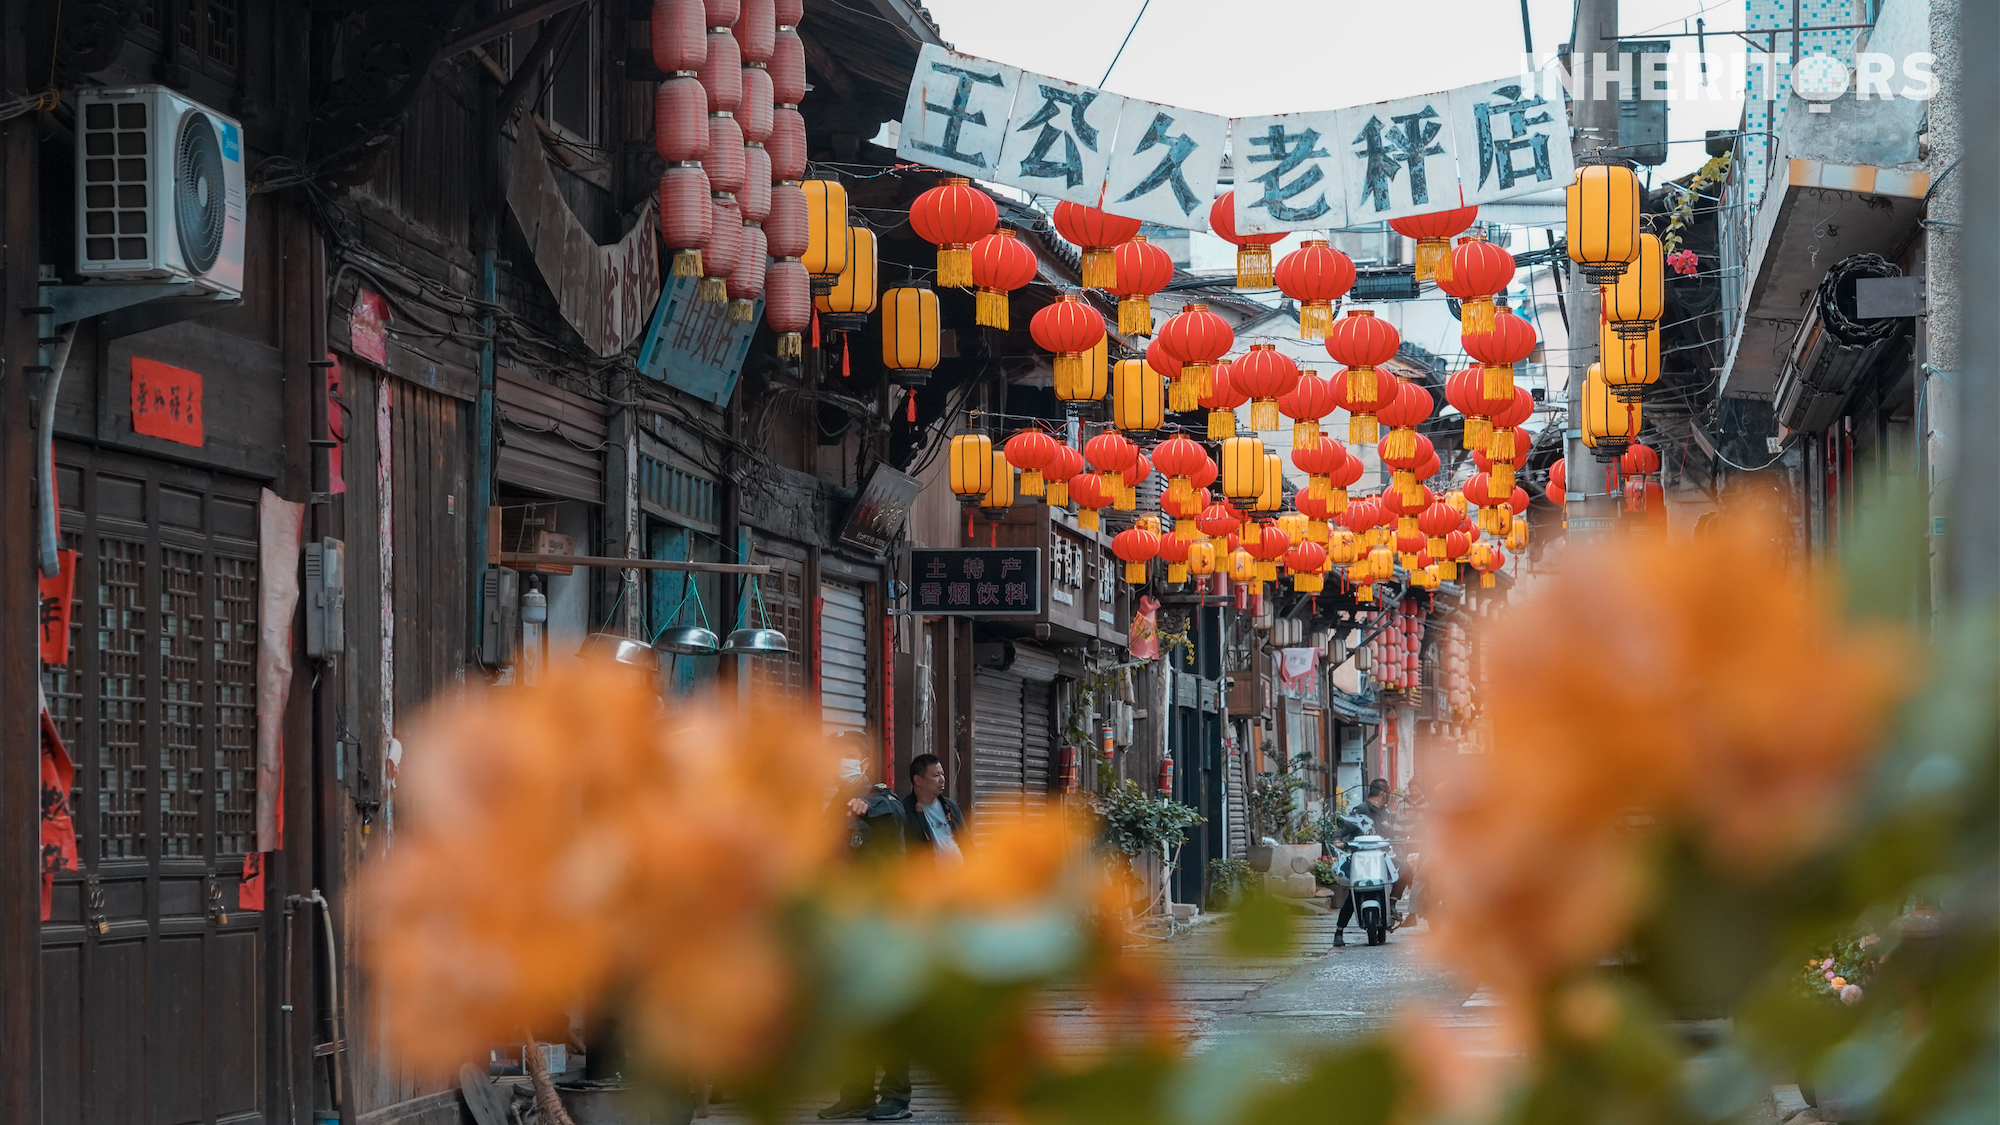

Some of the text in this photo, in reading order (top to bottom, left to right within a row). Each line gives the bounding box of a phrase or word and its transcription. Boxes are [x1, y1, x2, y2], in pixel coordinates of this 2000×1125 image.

[910, 61, 1555, 222] 王公久老秤店
[926, 557, 1022, 580] 土特产
[920, 581, 1029, 606] 香烟饮料
